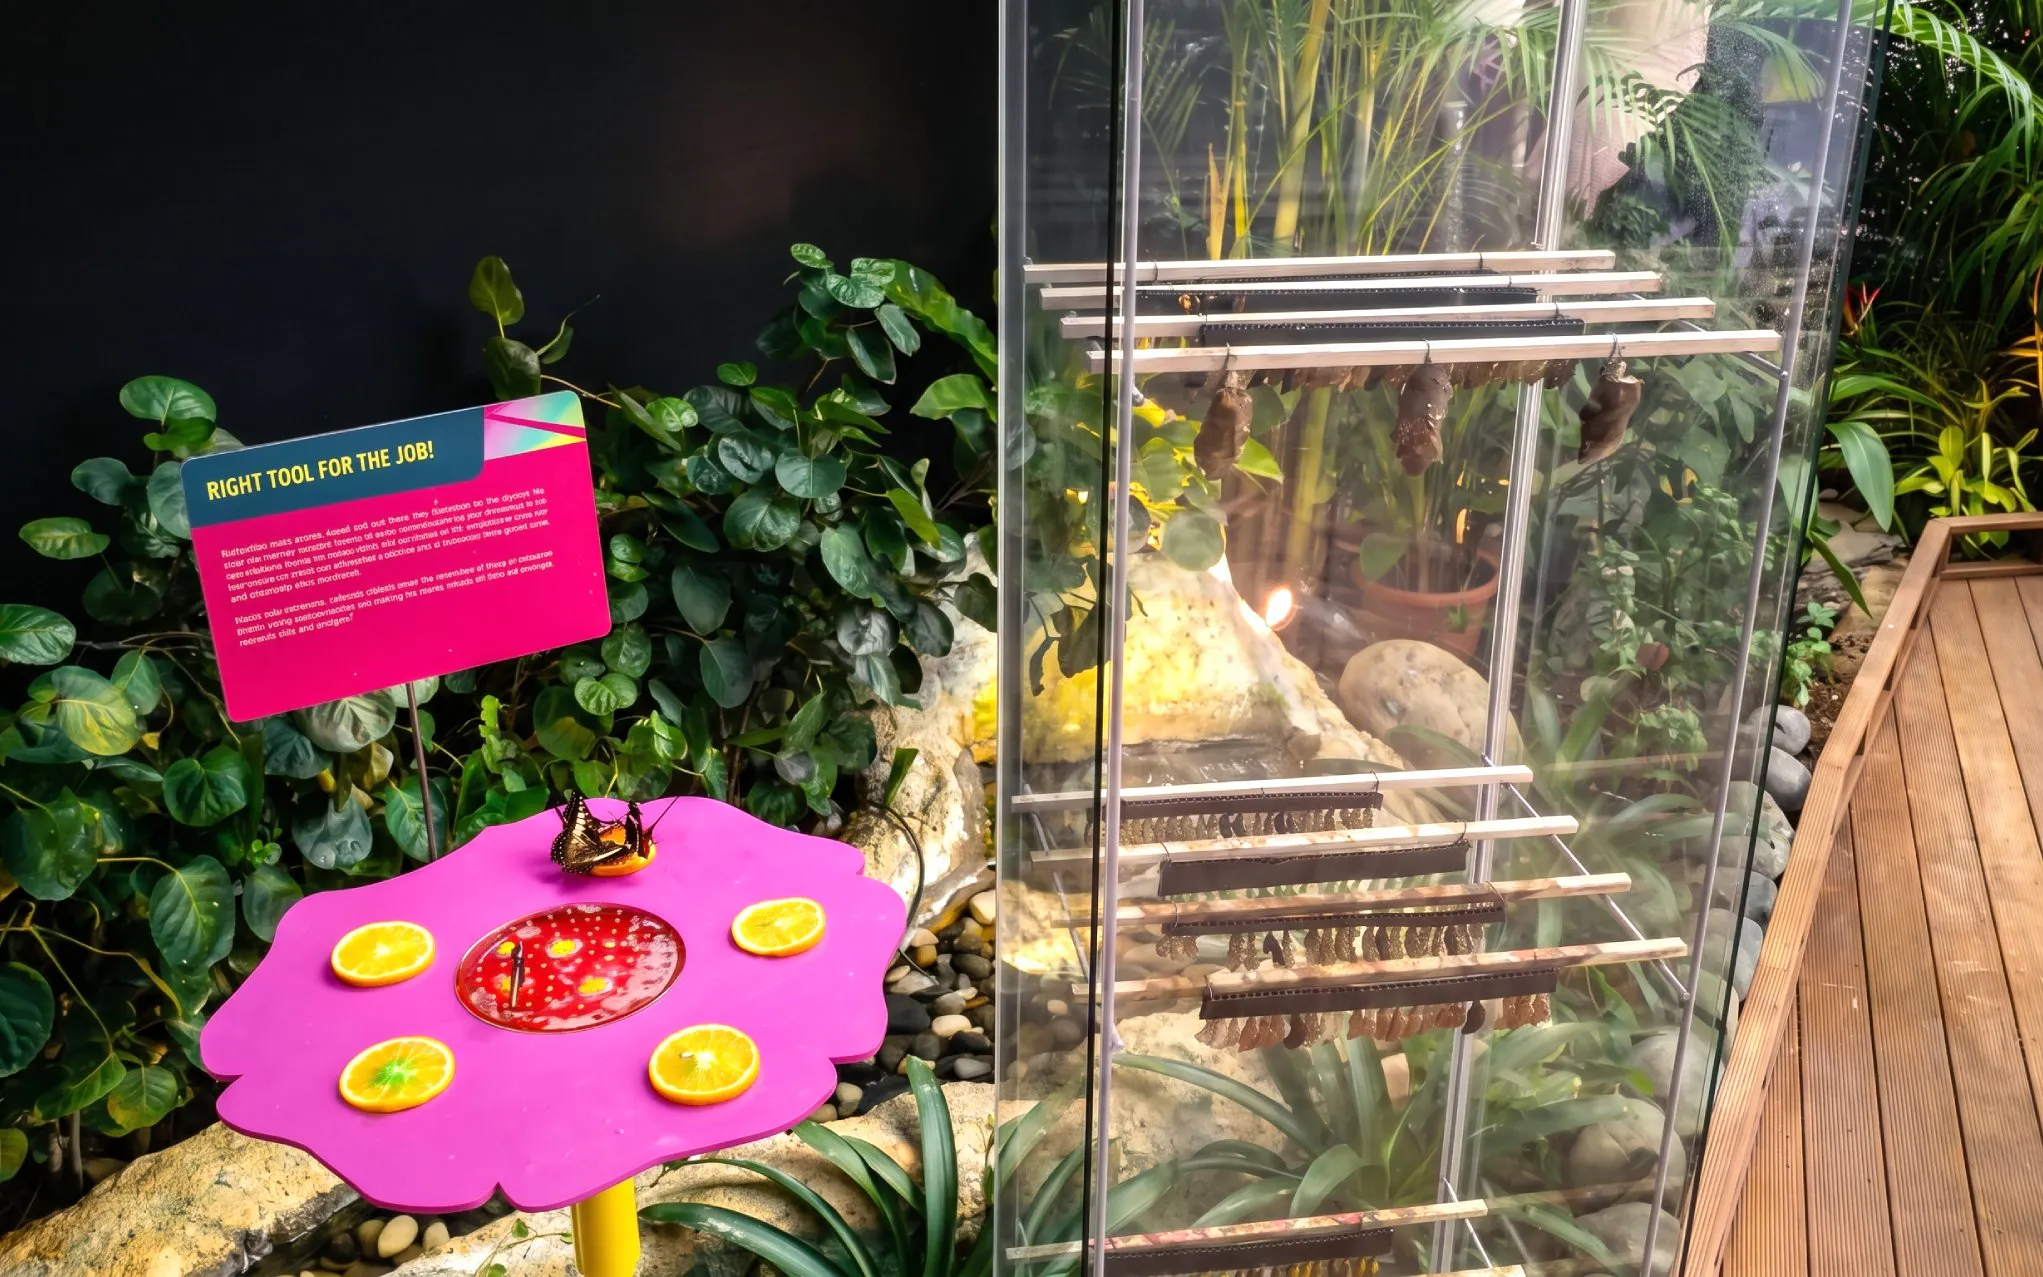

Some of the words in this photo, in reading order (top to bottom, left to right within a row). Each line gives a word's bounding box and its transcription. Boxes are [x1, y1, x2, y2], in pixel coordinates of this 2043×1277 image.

[206, 472, 262, 501] RIGHT
[266, 464, 314, 489] TOOL
[318, 455, 354, 479] FOR
[356, 448, 391, 472] THE
[395, 440, 435, 465] JOB!
